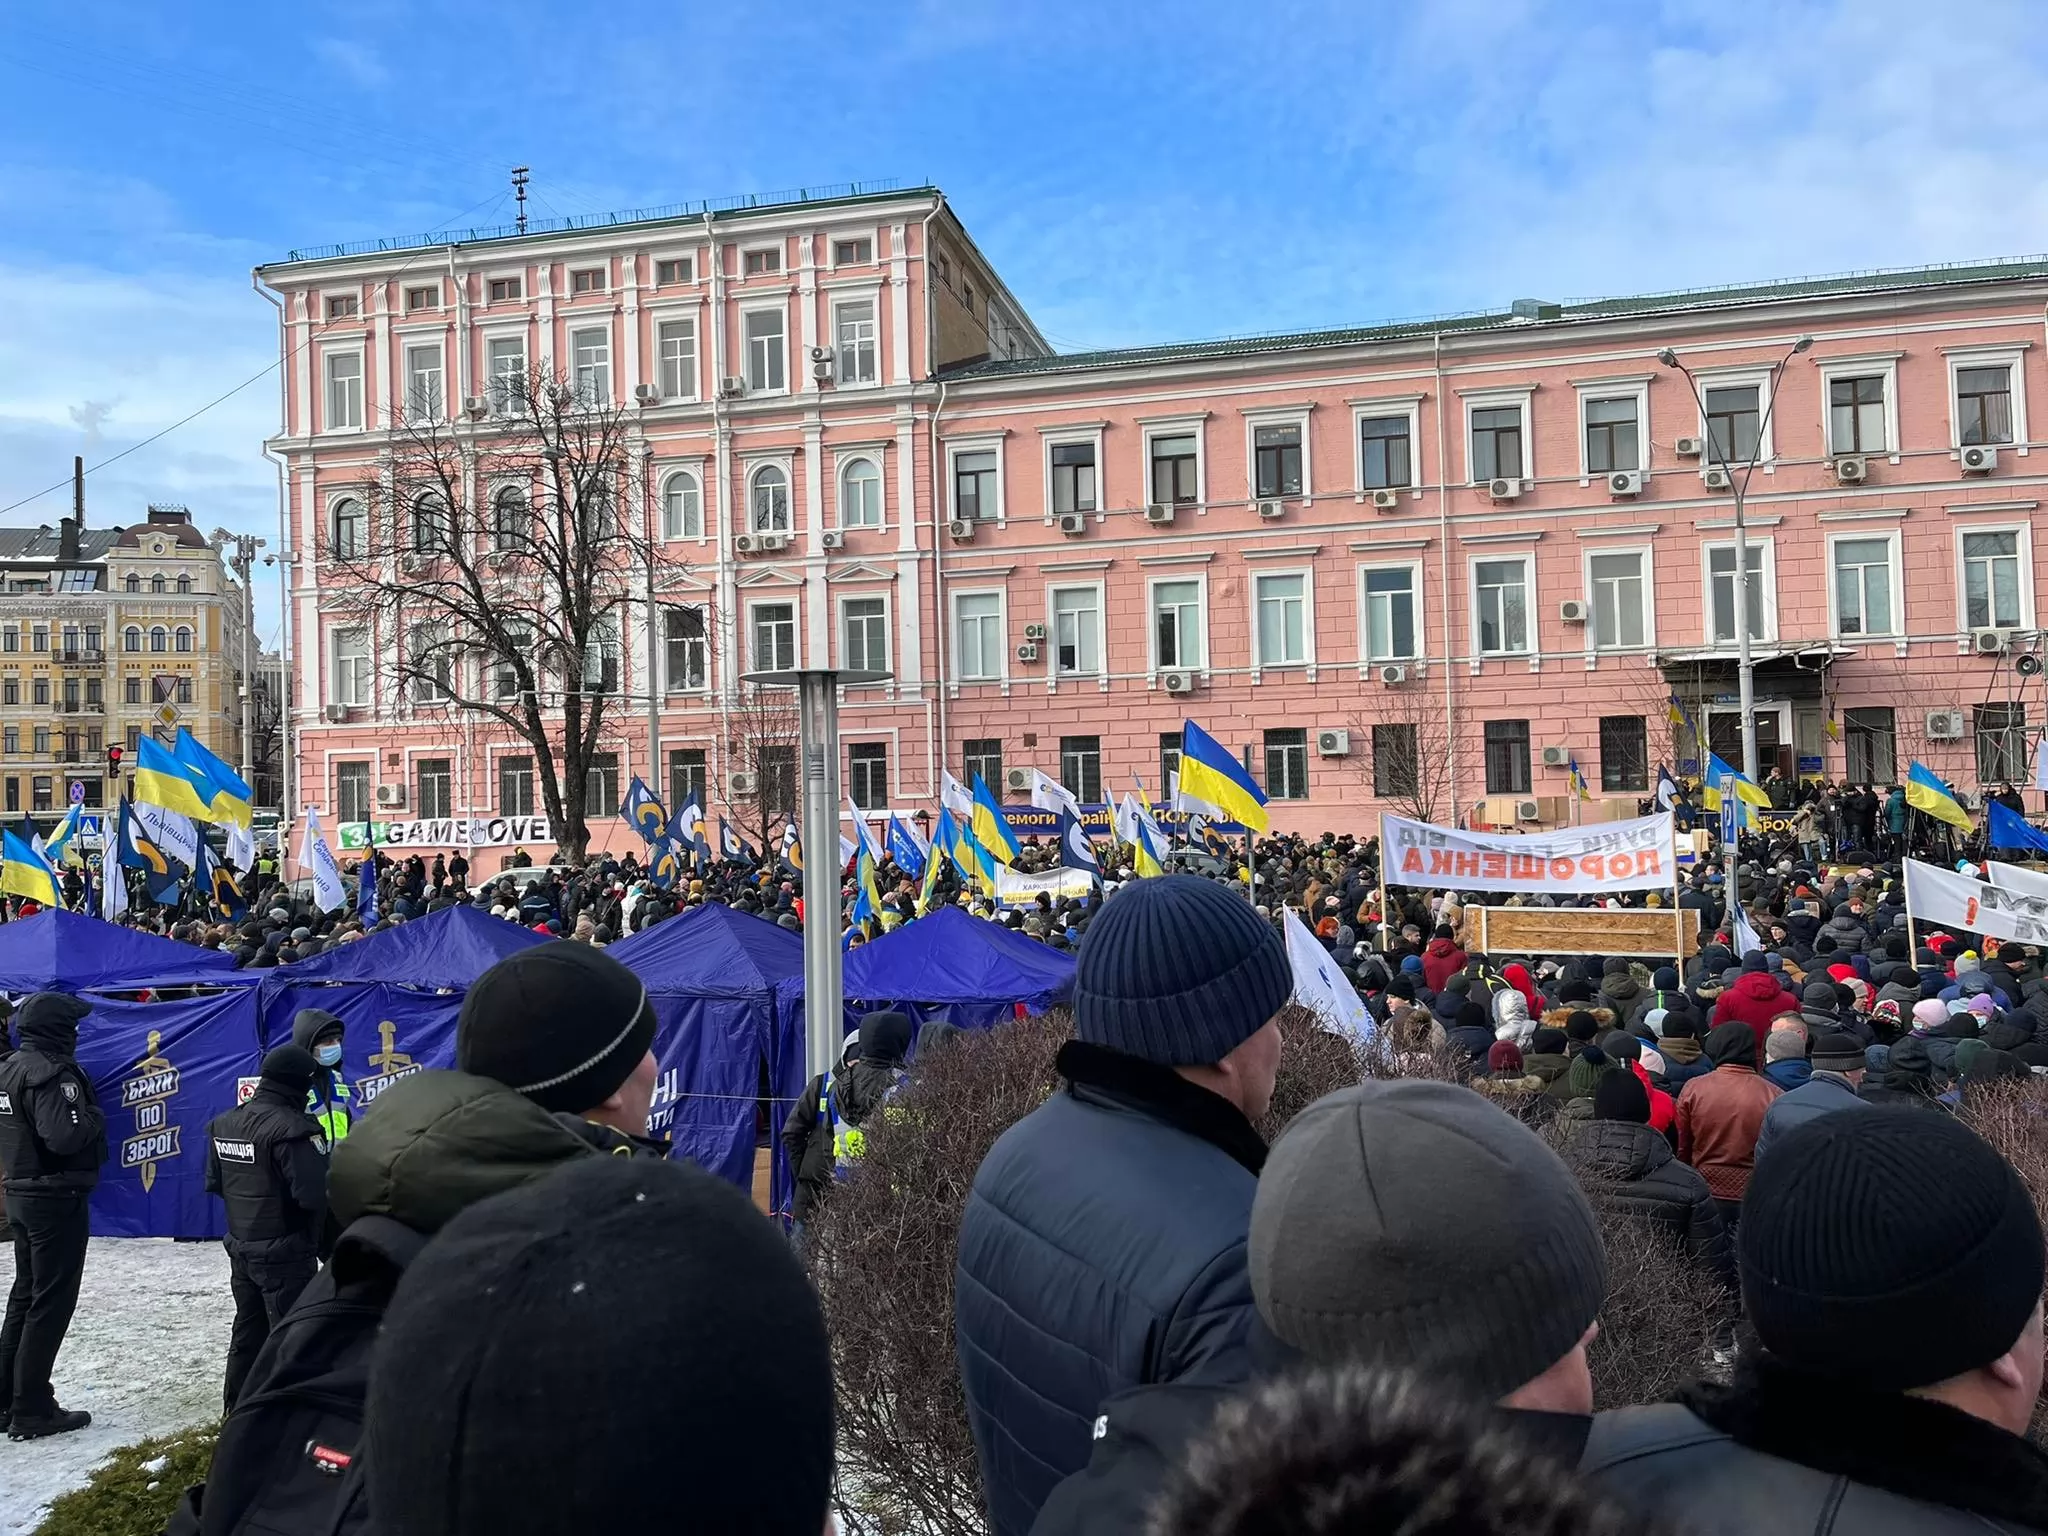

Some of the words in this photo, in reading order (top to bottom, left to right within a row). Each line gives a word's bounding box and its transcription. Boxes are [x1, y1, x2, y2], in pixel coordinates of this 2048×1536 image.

[386, 819, 468, 845] GAME
[487, 817, 555, 843] OVE
[1001, 814, 1057, 825] емоги
[128, 1072, 173, 1101] БРАТИ
[140, 1104, 161, 1128] ПО
[126, 1131, 172, 1163] ЗБРОЇ
[215, 1141, 254, 1159] ПОЛІЦІЯ
